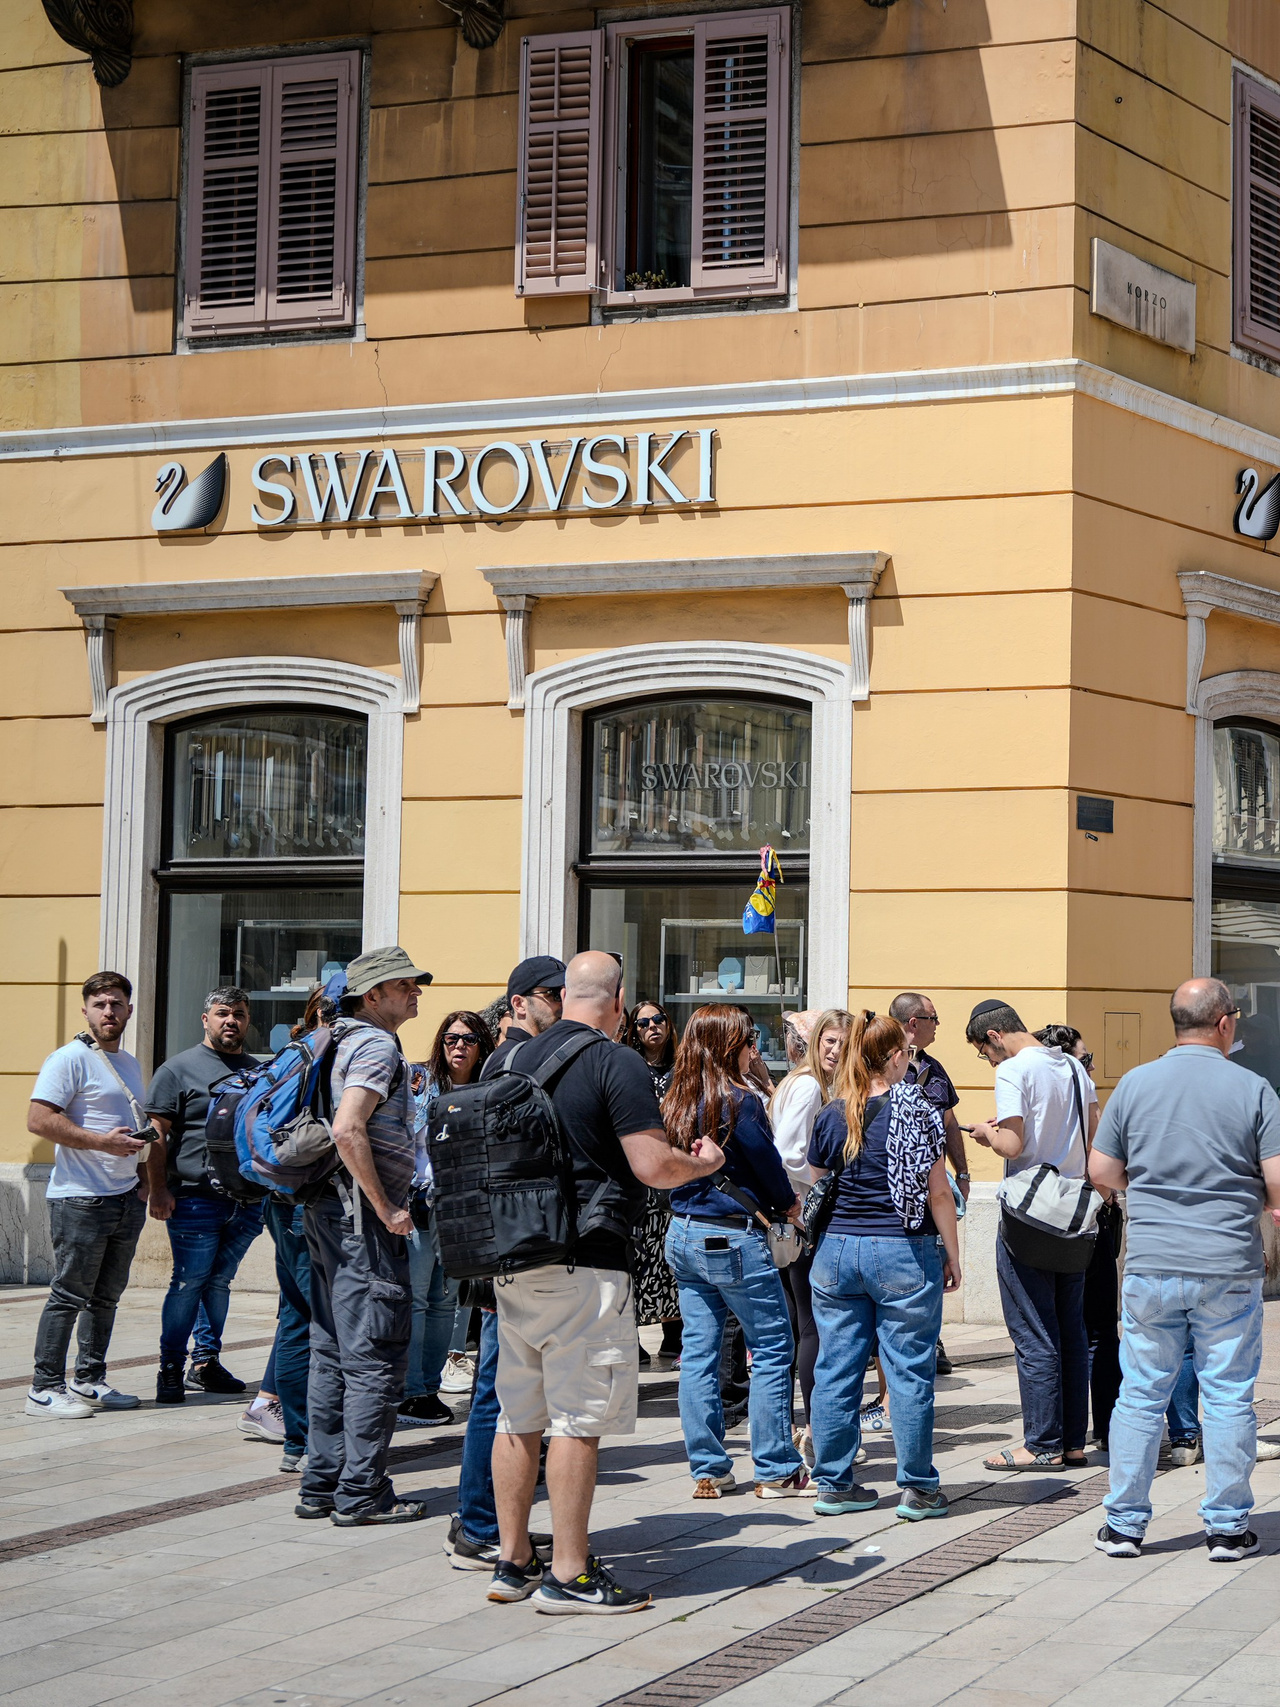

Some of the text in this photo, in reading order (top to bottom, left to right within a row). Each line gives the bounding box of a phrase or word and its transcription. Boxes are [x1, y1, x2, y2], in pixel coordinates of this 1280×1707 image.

[1127, 282, 1167, 310] KORZO
[251, 428, 718, 526] SWAROVSKI
[641, 762, 811, 790] SWAROVSKI
